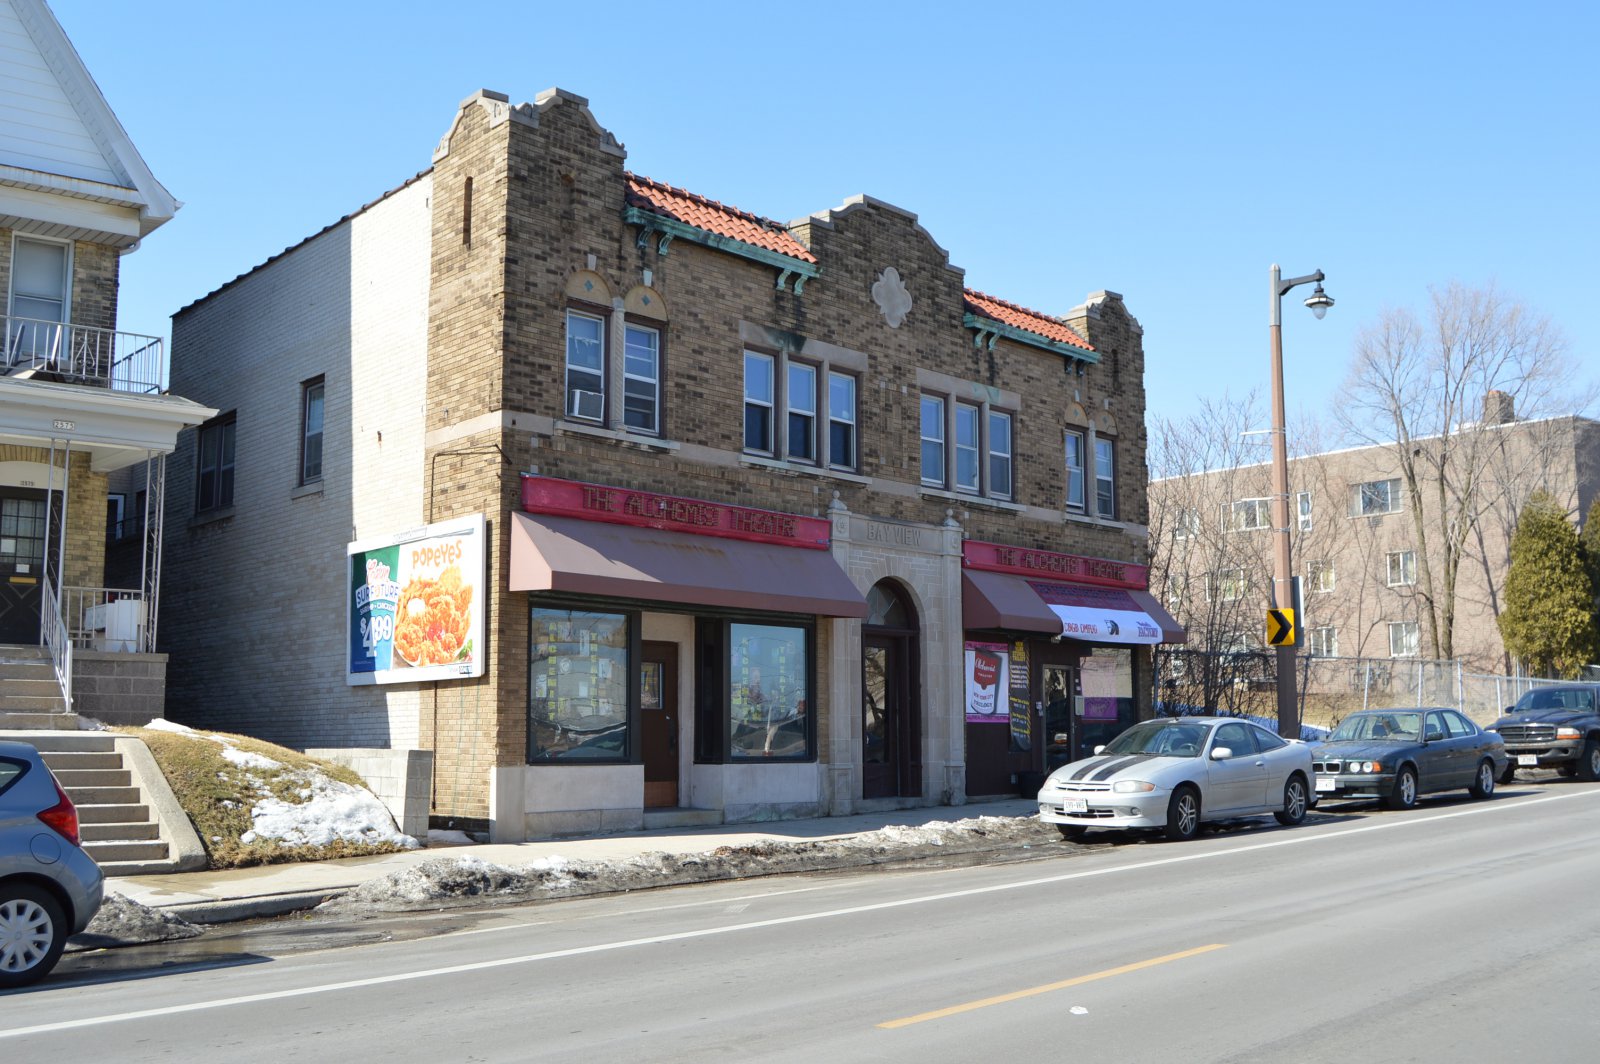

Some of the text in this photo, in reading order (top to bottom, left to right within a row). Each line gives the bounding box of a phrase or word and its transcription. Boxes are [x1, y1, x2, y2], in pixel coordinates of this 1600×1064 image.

[582, 487, 800, 538] THE ALCHEMIST THEATRE
[867, 522, 921, 547] BAY VIEW
[1021, 551, 1084, 575] ALCHEMIST
